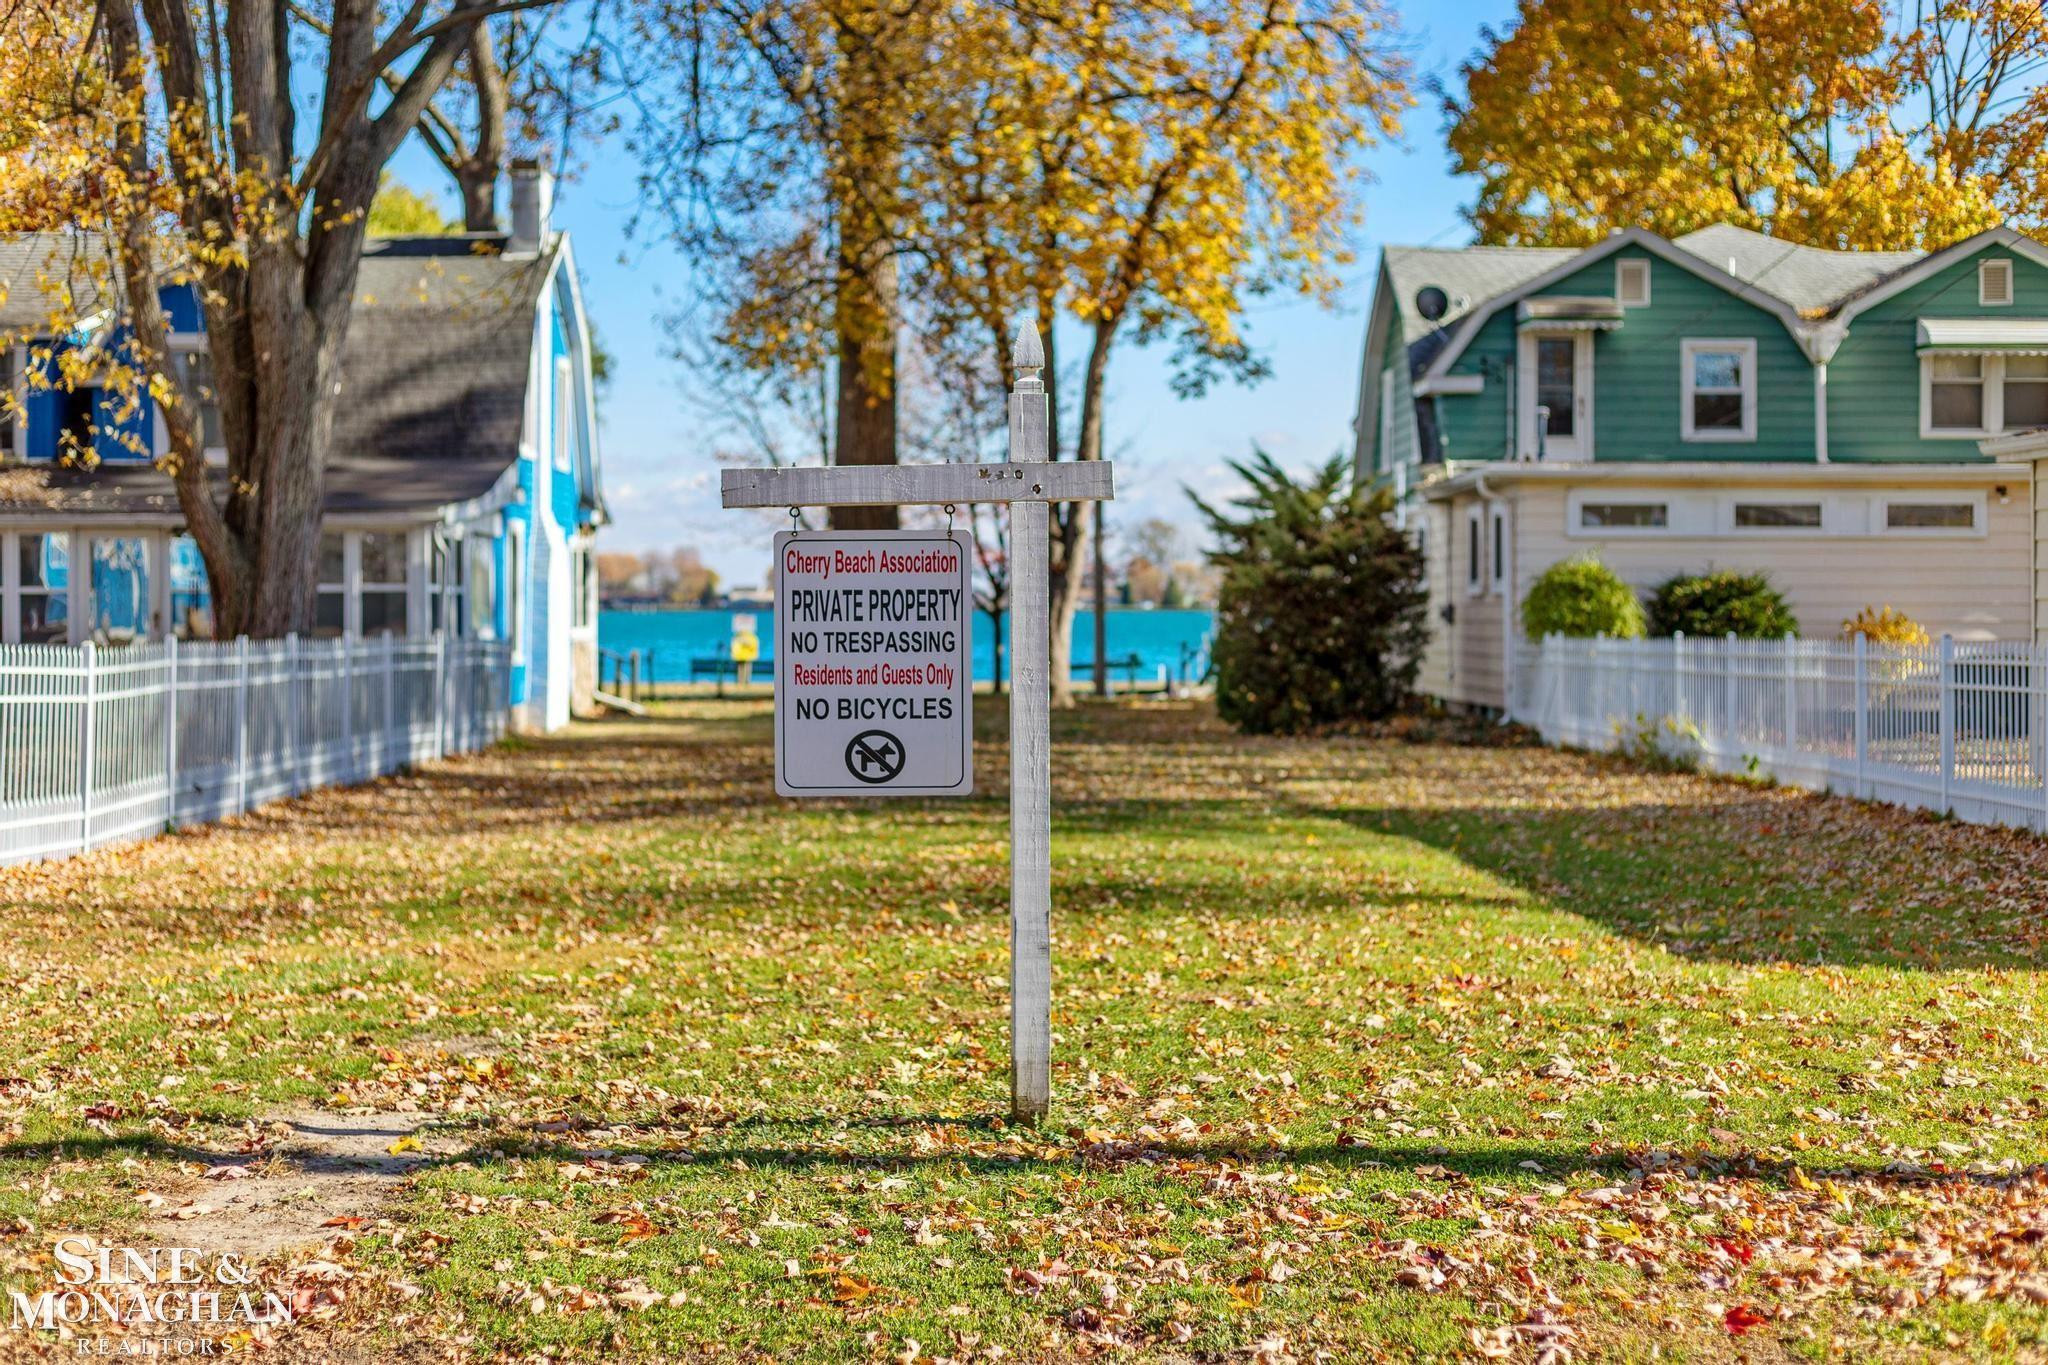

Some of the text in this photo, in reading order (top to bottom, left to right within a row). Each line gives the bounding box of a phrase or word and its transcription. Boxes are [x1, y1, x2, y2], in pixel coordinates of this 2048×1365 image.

[786, 550, 958, 579] Cherry Beach Association
[791, 588, 961, 622] PRIVATE PROPERTY
[791, 631, 955, 653] NO TRESPASSING
[794, 663, 954, 690] Residents and Guests Only
[796, 697, 953, 720] NO BICYCLES
